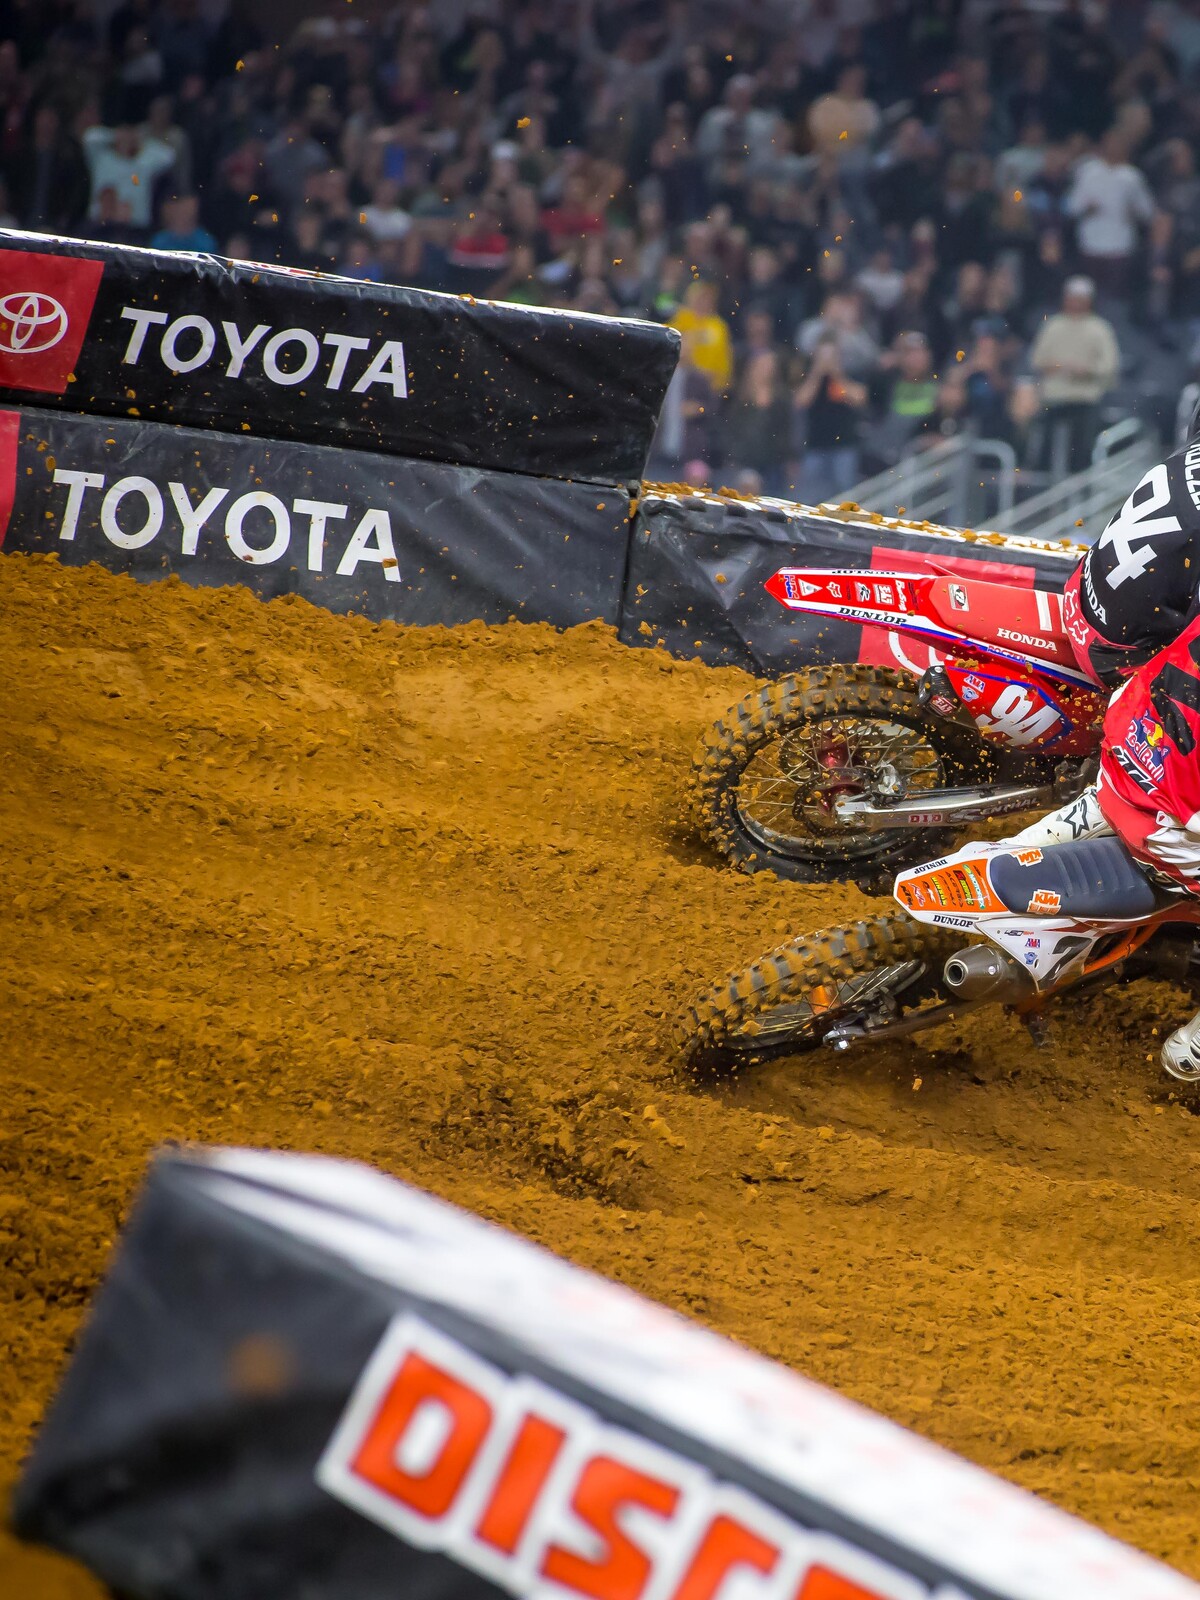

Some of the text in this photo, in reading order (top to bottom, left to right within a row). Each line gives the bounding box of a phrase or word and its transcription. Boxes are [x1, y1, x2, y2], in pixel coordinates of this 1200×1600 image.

[120, 306, 408, 399] TOYOTA
[52, 469, 402, 582] TOYOTA
[1099, 464, 1182, 590] 94
[839, 607, 907, 625] DUNLOP
[996, 628, 1057, 651] HONDA
[914, 859, 948, 875] DUNLOP
[1034, 891, 1060, 906] KTM
[933, 914, 973, 928] DUNLOP
[1025, 938, 1041, 947] AMA
[345, 1343, 890, 1600] DISC
